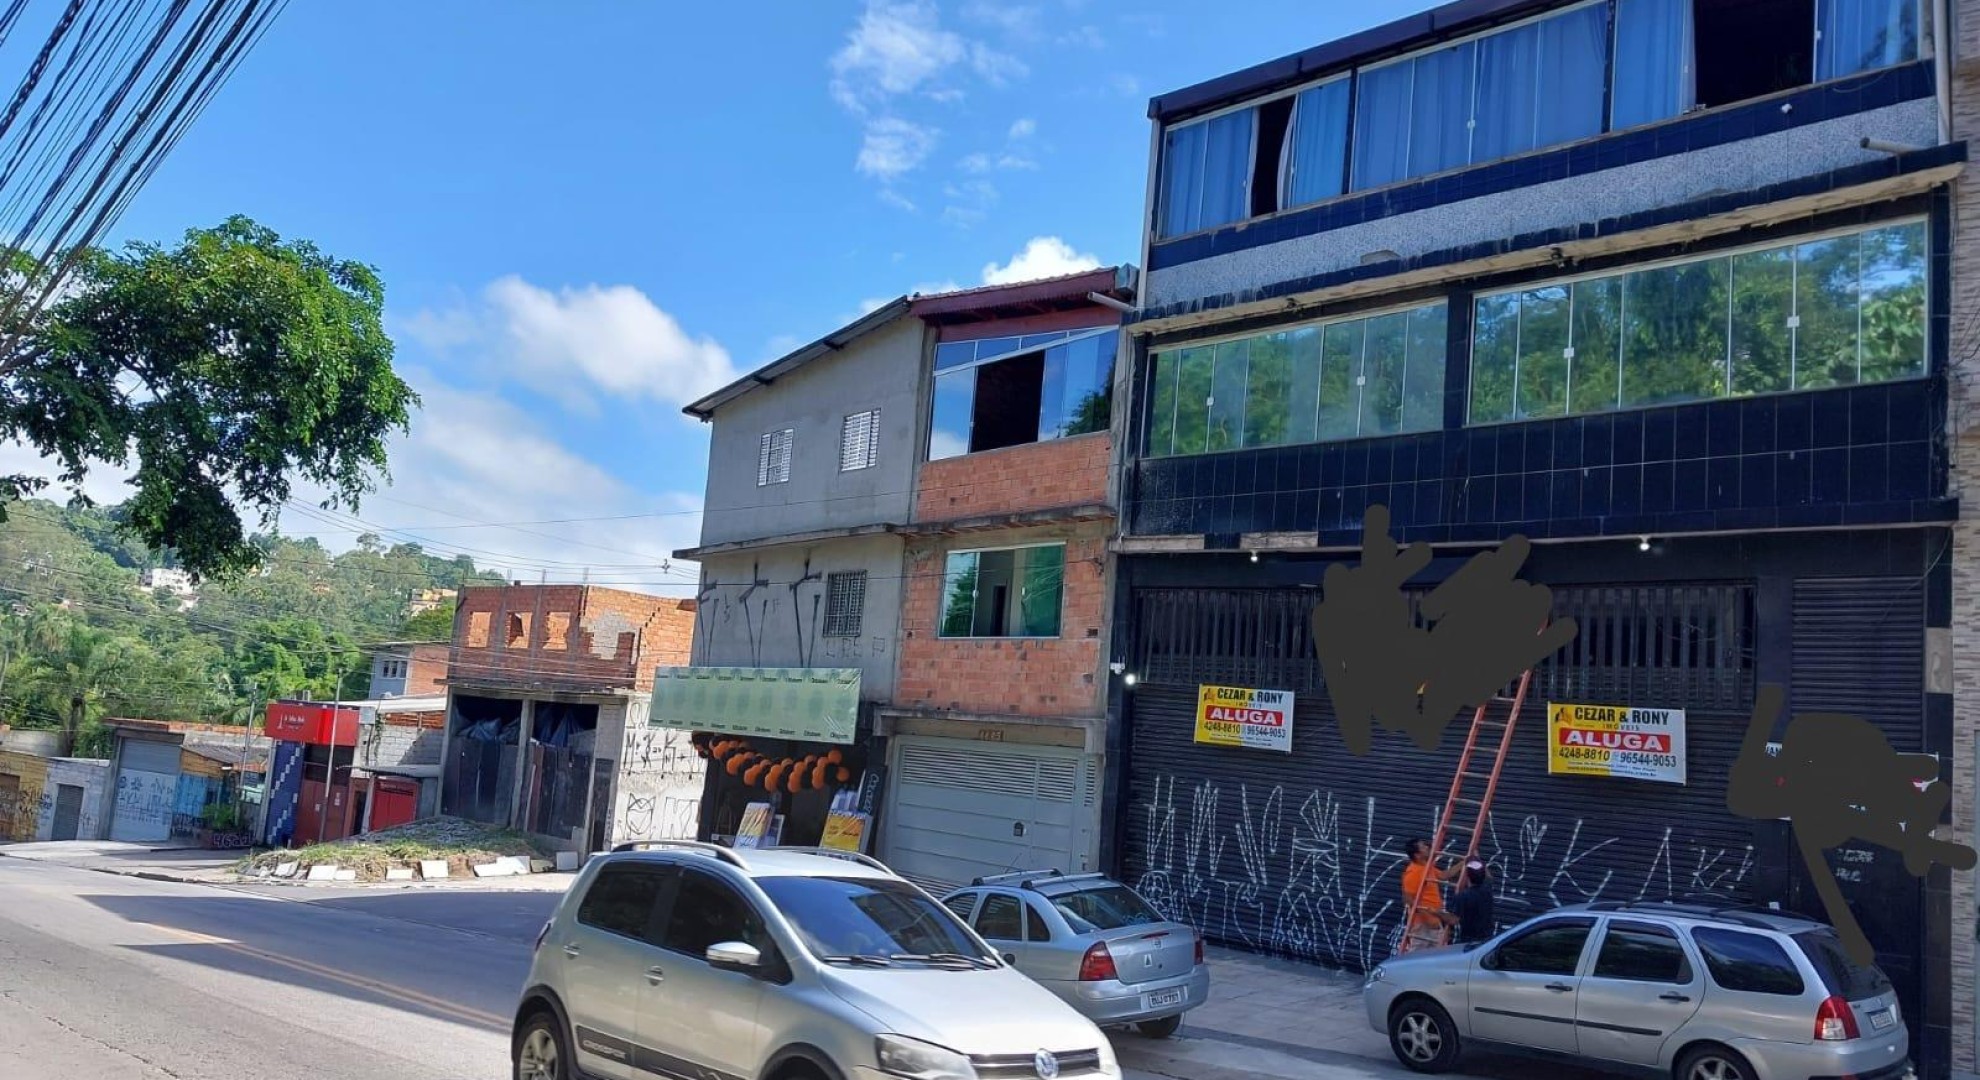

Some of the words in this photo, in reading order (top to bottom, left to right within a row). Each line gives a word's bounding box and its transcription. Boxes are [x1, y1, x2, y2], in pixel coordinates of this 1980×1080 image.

[1217, 688, 1246, 701] CEZAR
[1248, 692, 1255, 702] &
[1257, 691, 1284, 704] RONY
[1210, 707, 1278, 725] ALUGA
[1574, 707, 1615, 722] CEZAR
[1619, 711, 1628, 723] &
[1631, 710, 1669, 725] RONY
[1204, 721, 1240, 734] 4248-8810
[1565, 730, 1664, 751] ALUGA
[1559, 747, 1610, 761] 4248-8810
[1620, 752, 1677, 768] 96544-9053
